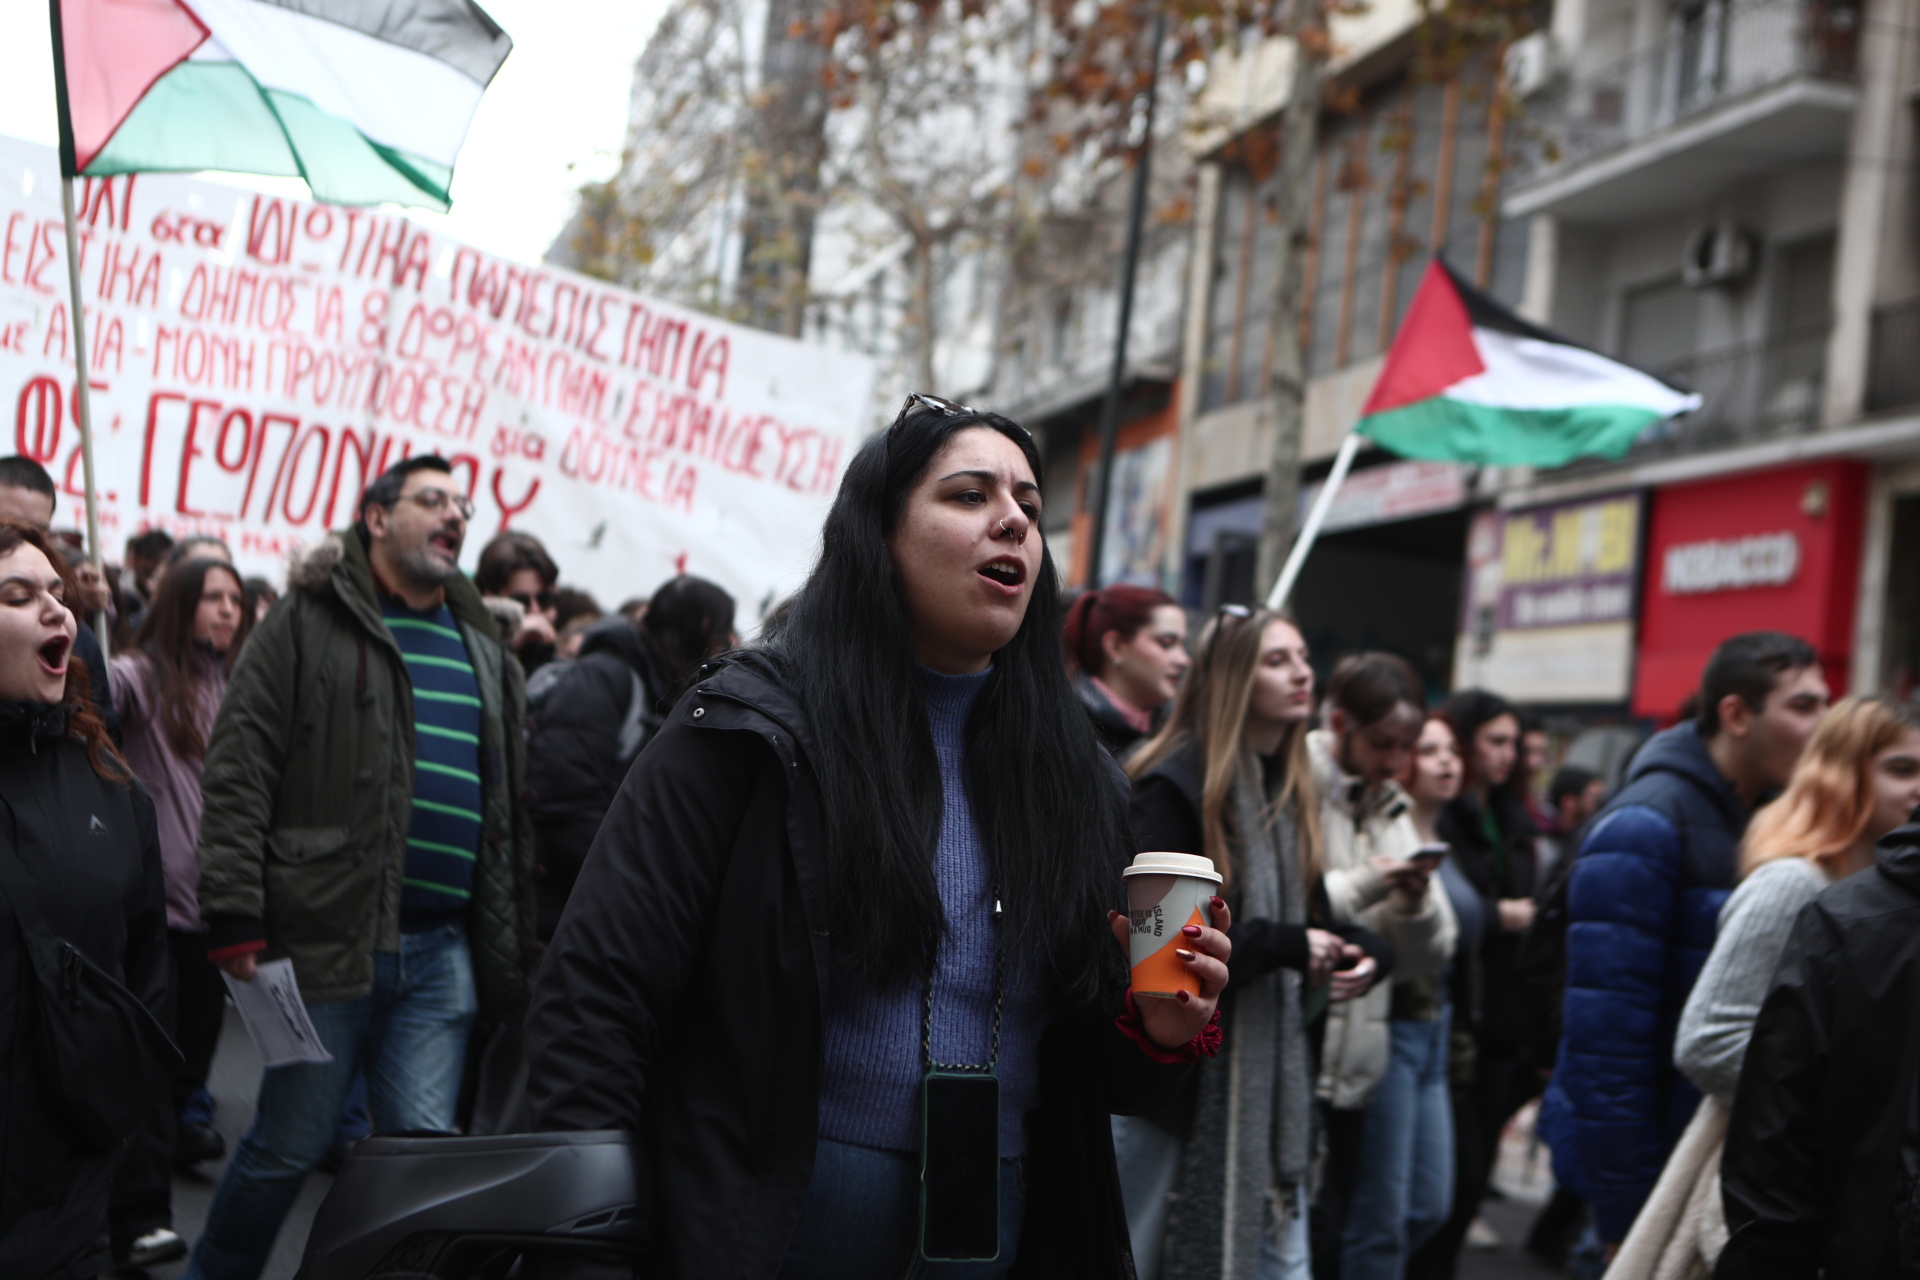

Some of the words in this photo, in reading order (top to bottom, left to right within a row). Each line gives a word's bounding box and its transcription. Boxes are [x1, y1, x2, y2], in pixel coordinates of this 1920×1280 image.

[76, 172, 137, 232] ΧΙ
[180, 261, 344, 342] ΔΗΜΟΣΙΑ
[43, 302, 123, 374] ΑΙΑ
[152, 321, 256, 393] ΜΟΝΗ
[138, 390, 541, 532] ΓΕΩΠΟΝΥ
[1138, 925, 1151, 934] MUG
[1153, 905, 1163, 936] ISLAND
